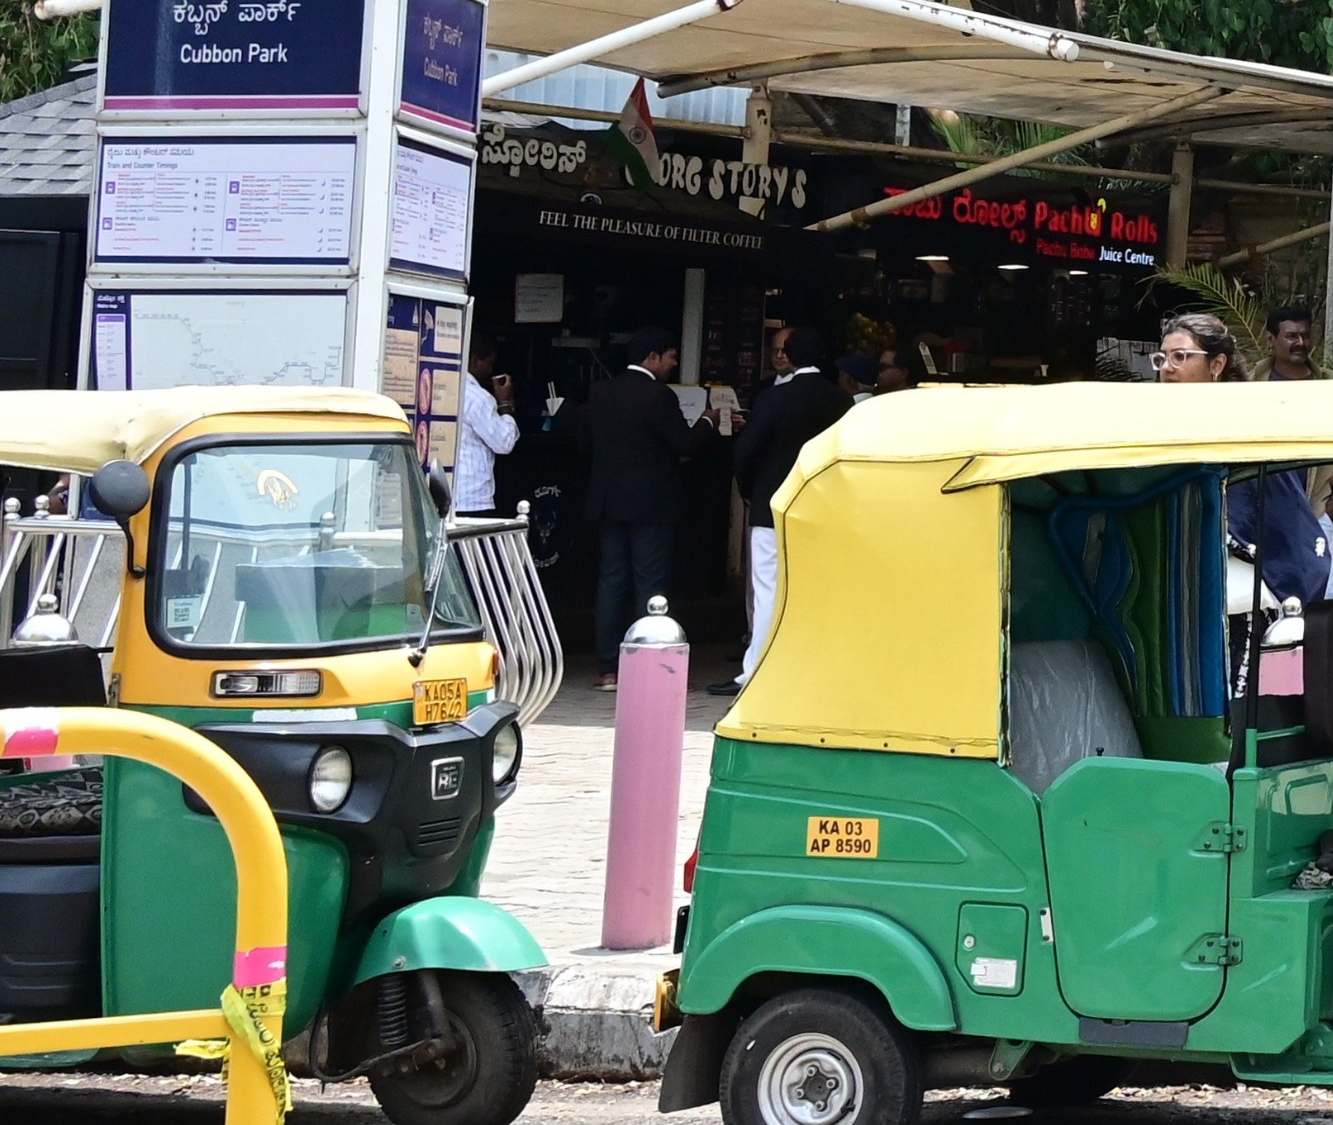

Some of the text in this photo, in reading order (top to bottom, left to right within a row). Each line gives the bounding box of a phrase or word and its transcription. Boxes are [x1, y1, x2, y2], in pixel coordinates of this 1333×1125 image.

[173, 0, 301, 35] ಕಬ್ಬನ್ ಪಾರ್ಕ್
[180, 43, 288, 63] Cubbon Park
[424, 57, 459, 87] Cubbon Park
[539, 210, 764, 250] FEEL THE PLEASURE OF FILTER COFFEE
[1110, 212, 1159, 244] Rolls
[1099, 245, 1123, 263] Juice
[1124, 248, 1155, 266] Centre
[424, 682, 462, 702] KA05A
[425, 702, 462, 722] H7642
[437, 771, 458, 791] RE
[819, 820, 862, 836] KA 03
[810, 838, 871, 853] AP 8590
